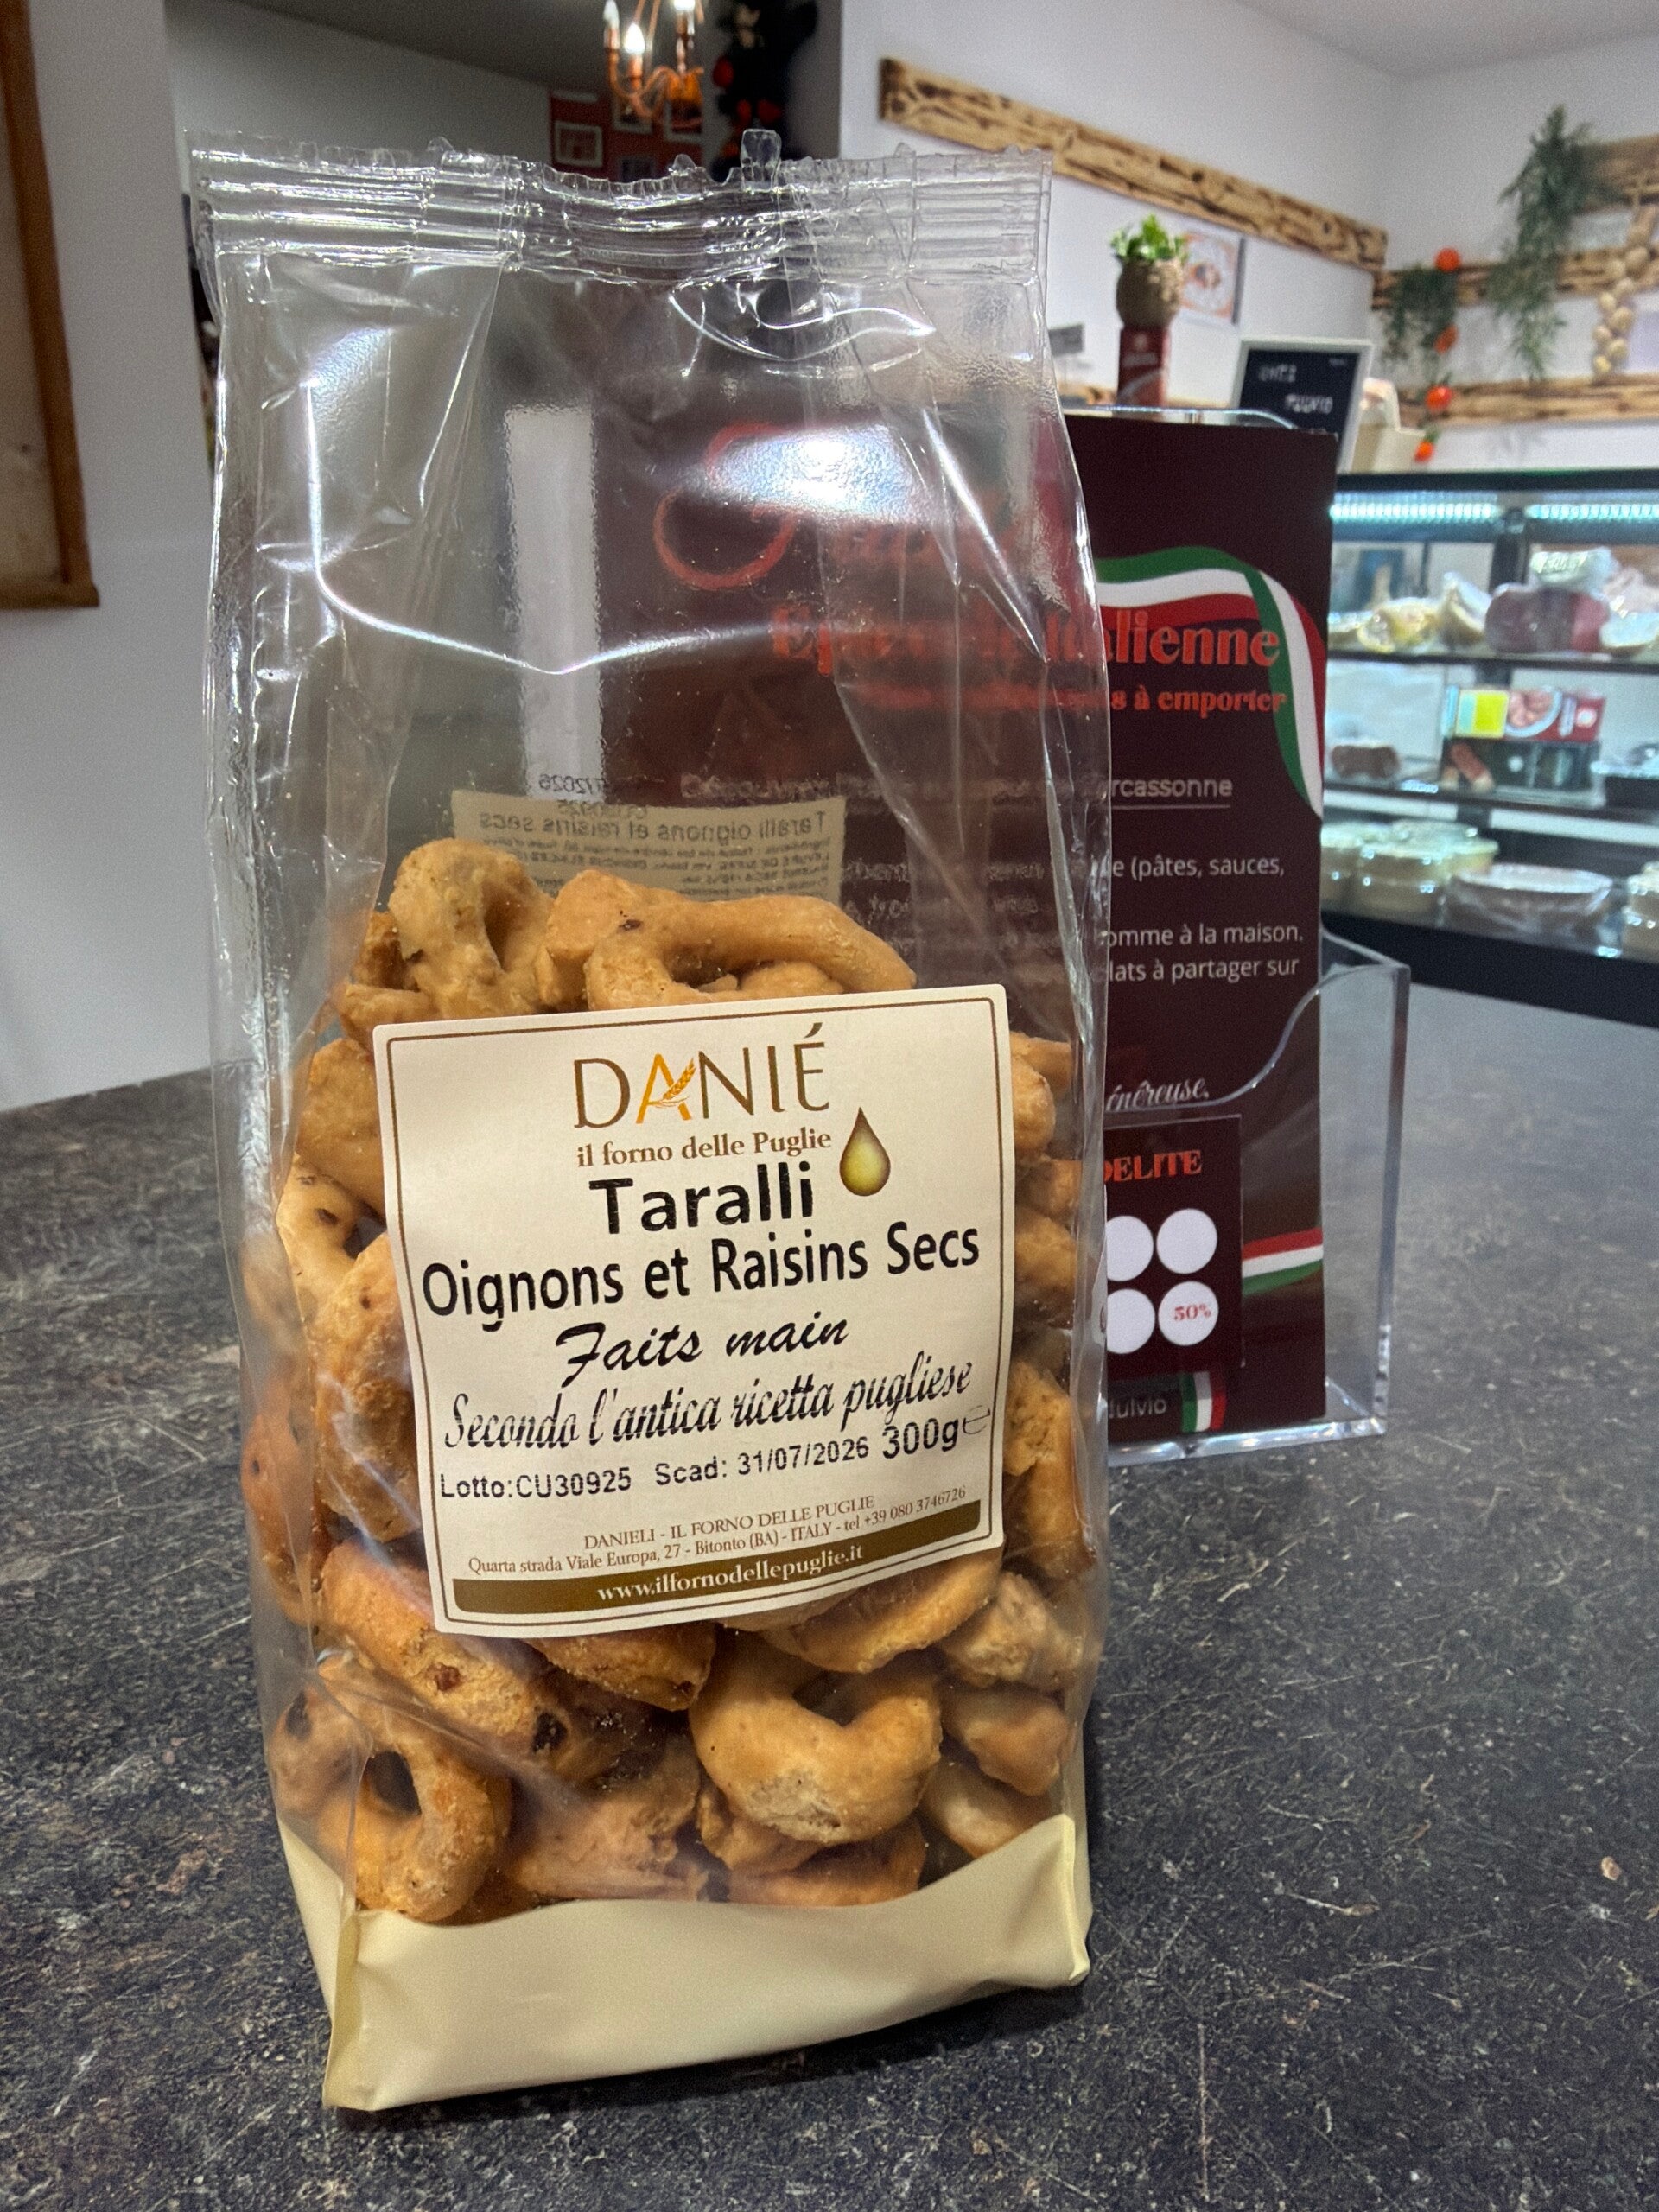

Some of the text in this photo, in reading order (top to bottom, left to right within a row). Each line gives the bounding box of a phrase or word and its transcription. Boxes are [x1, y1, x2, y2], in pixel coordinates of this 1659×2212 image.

[1134, 684, 1150, 710] à
[1157, 690, 1287, 719] emporter
[1111, 779, 1233, 797] rcassonne
[1131, 854, 1203, 881] (pâtes,
[1210, 856, 1284, 877] sauces,
[1109, 922, 1303, 947] omme à la maison.
[1109, 959, 1300, 984] lats à partager sur
[574, 1022, 830, 1128] DANIÉ
[1106, 1078, 1209, 1111] énéreuse.
[577, 1127, 832, 1167] il forno delle Puglie
[1103, 1150, 1202, 1182] DELITE
[588, 1160, 813, 1234] Taralli
[423, 1221, 980, 1332] Oignons et Raisins Secs
[1173, 1304, 1211, 1321] 50%
[556, 1311, 852, 1388] Faits main
[444, 1351, 973, 1449] Secondo l'antica ricetta pugliese
[441, 1466, 632, 1498] Lotto:CU30925
[654, 1455, 727, 1485] Scad:
[737, 1436, 870, 1476] 31/07/2026
[468, 1557, 517, 1575] Quarta
[519, 1556, 562, 1573] strada
[566, 1554, 602, 1571] Viale
[607, 1549, 660, 1567] Europa,
[664, 1543, 681, 1560] 27
[695, 1536, 746, 1556] Bitonto
[749, 1530, 779, 1549] (BA)
[791, 1522, 832, 1541] ITALY
[844, 1516, 860, 1531] tel
[865, 1510, 887, 1526] +39
[890, 1503, 913, 1519] 080
[916, 1485, 967, 1512] 3746726
[584, 1528, 655, 1550] DANIELI
[671, 1523, 687, 1540] IL
[691, 1516, 753, 1537] FORNO
[758, 1506, 812, 1528] DELLE
[817, 1495, 874, 1518] PUGLIE
[597, 1544, 863, 1601] www.ilfornodellepuglie.it
